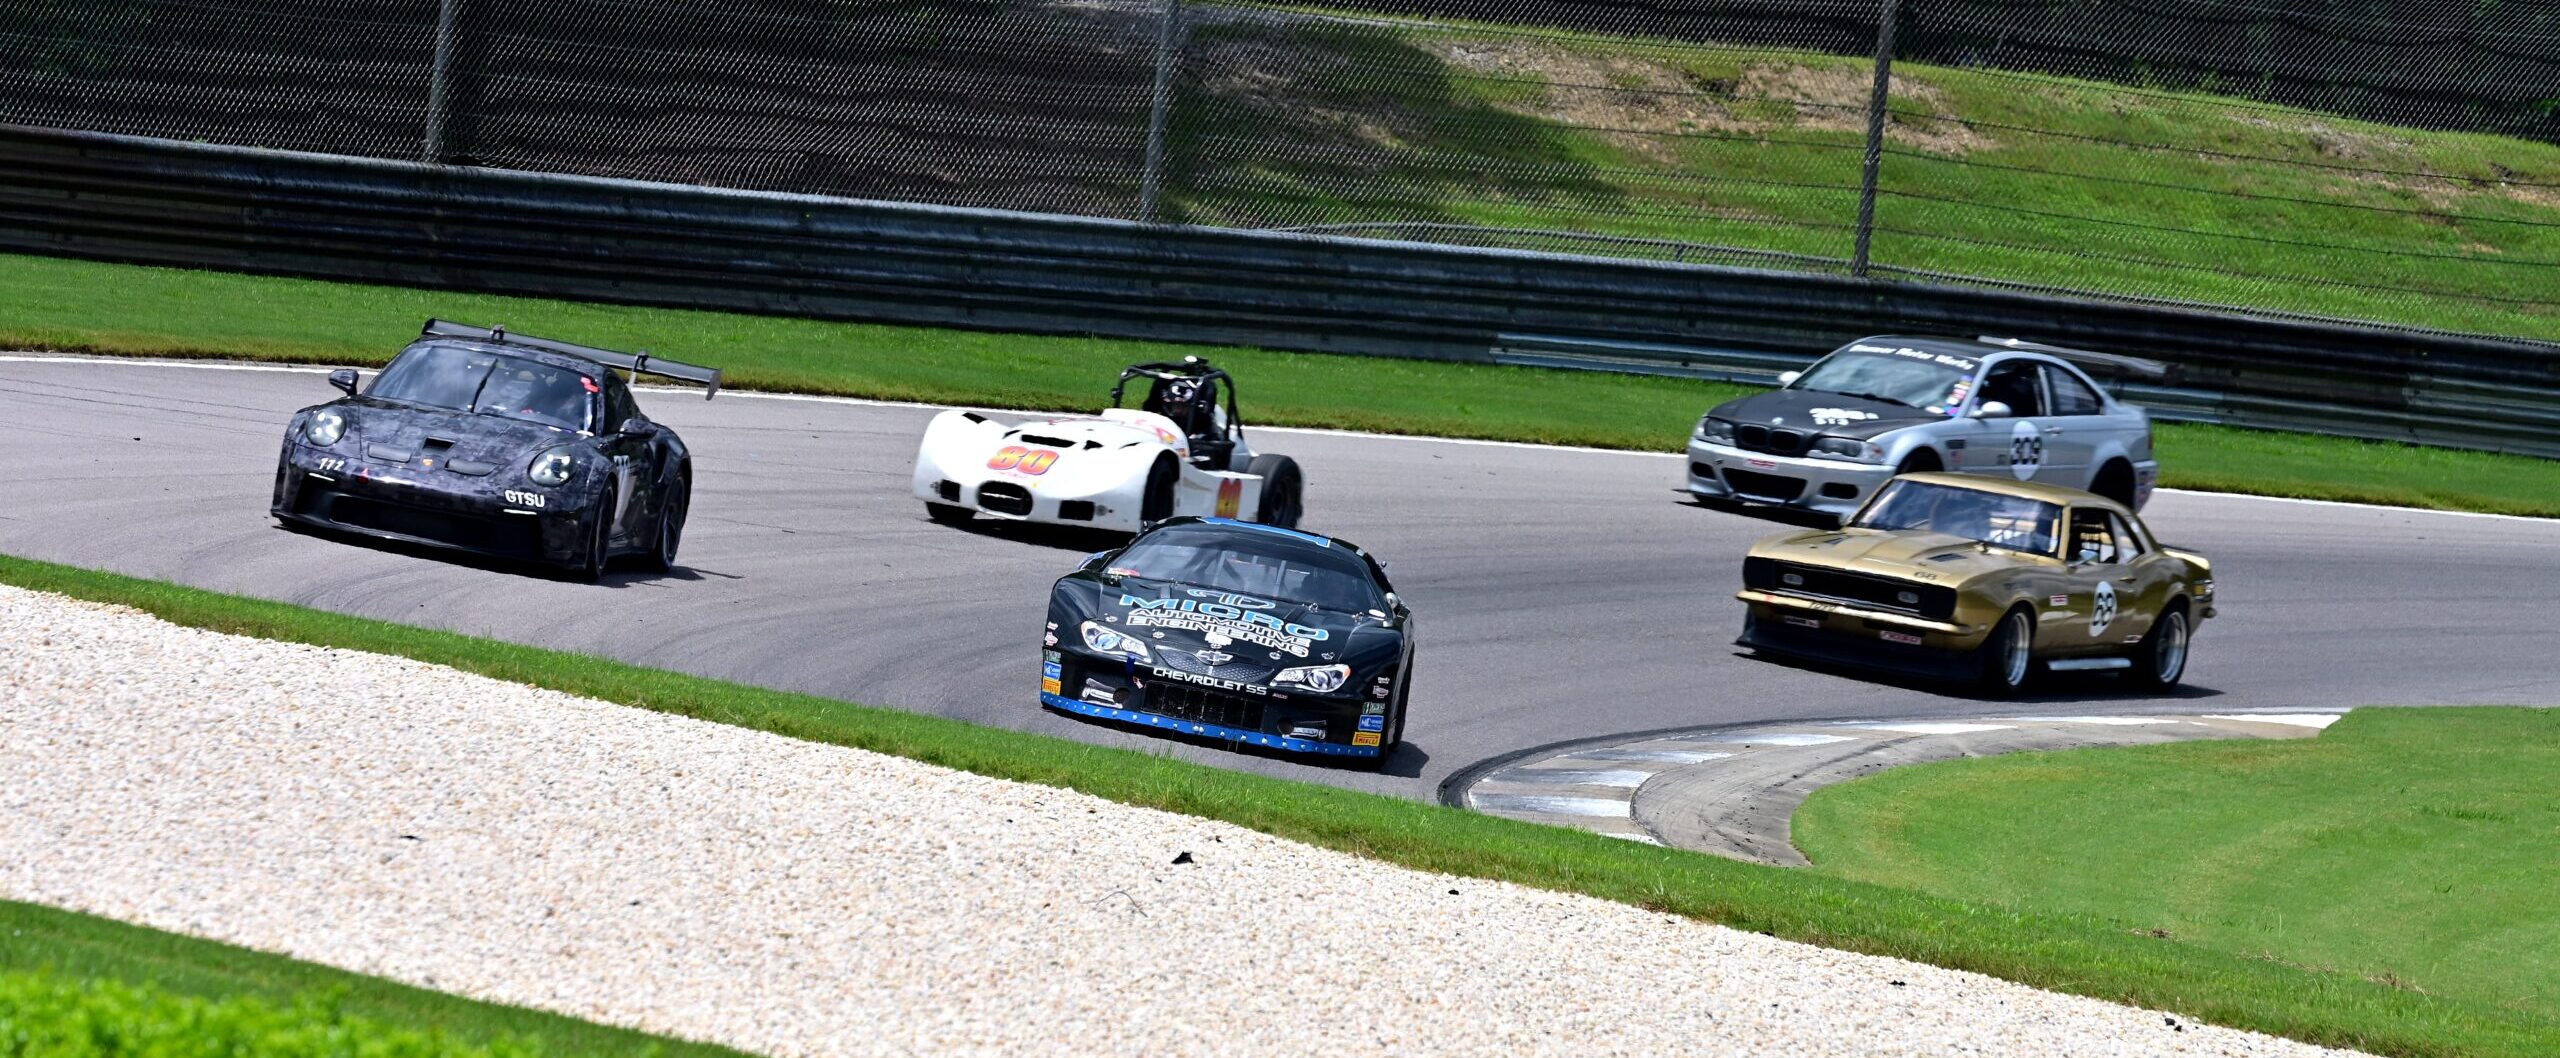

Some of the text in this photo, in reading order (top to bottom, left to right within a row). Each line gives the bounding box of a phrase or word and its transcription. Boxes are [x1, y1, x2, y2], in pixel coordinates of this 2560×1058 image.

[2011, 436, 2043, 465] 309
[504, 489, 545, 508] GTSU
[1119, 594, 1330, 641] MICRO
[1128, 608, 1312, 648] AUTOMOTIVE
[1126, 615, 1310, 658] ENGINEERING
[1153, 667, 1245, 692] CHEVROLET
[1245, 684, 1268, 696] SS
